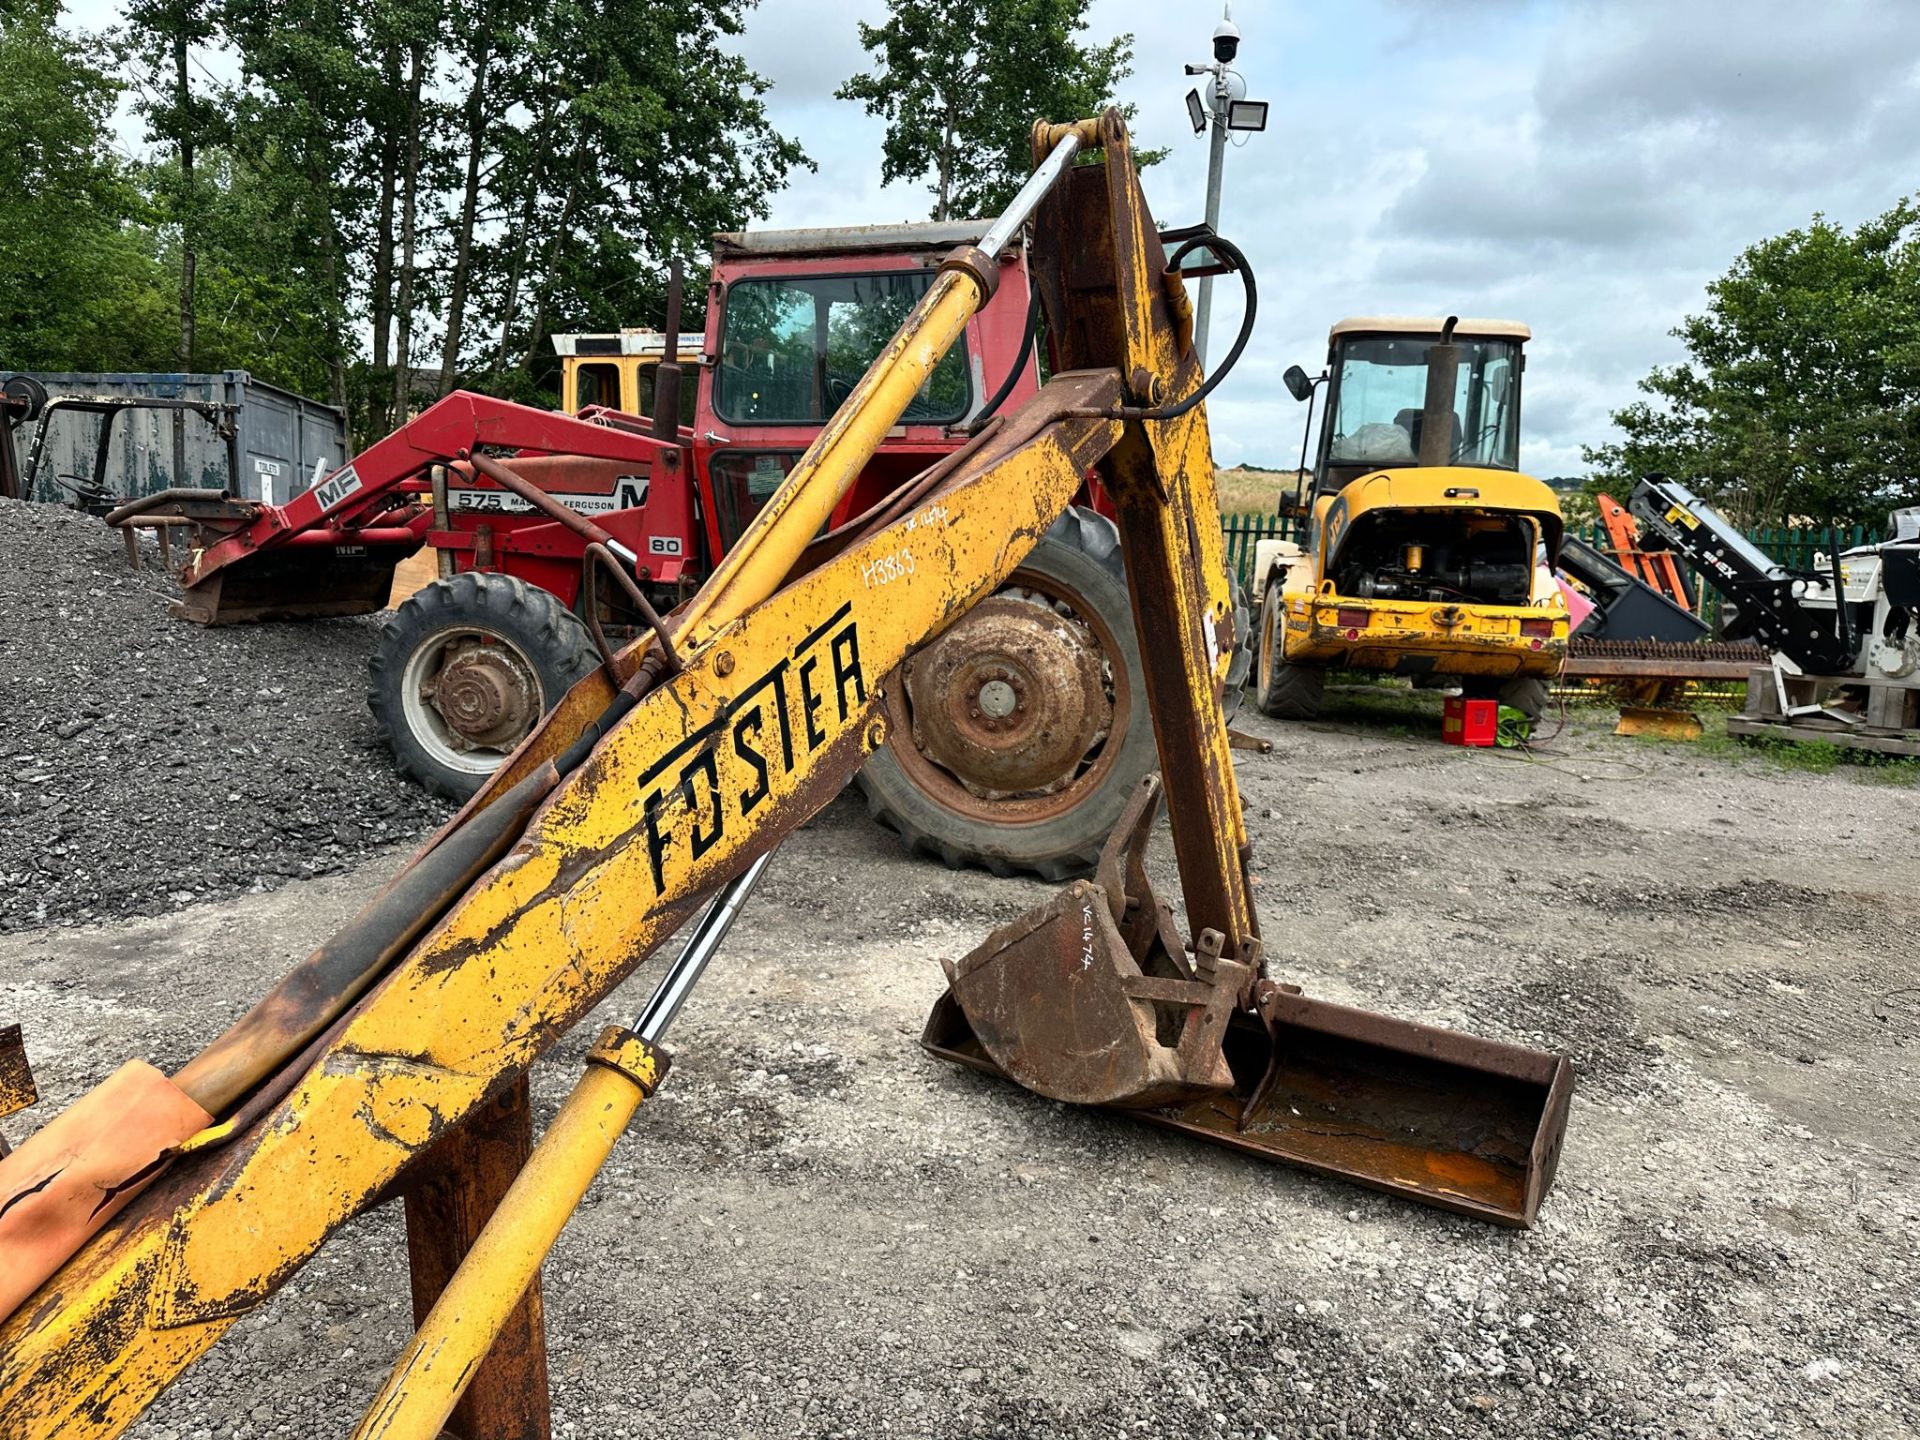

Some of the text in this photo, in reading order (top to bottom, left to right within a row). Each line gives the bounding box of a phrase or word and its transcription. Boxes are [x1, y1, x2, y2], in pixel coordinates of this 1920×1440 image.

[317, 468, 358, 508] MF
[458, 493, 615, 510] 575 MAS FERGUSON
[621, 484, 649, 510] M
[651, 539, 680, 552] 80
[860, 547, 916, 590] H3863
[637, 600, 867, 897] FOSTER
